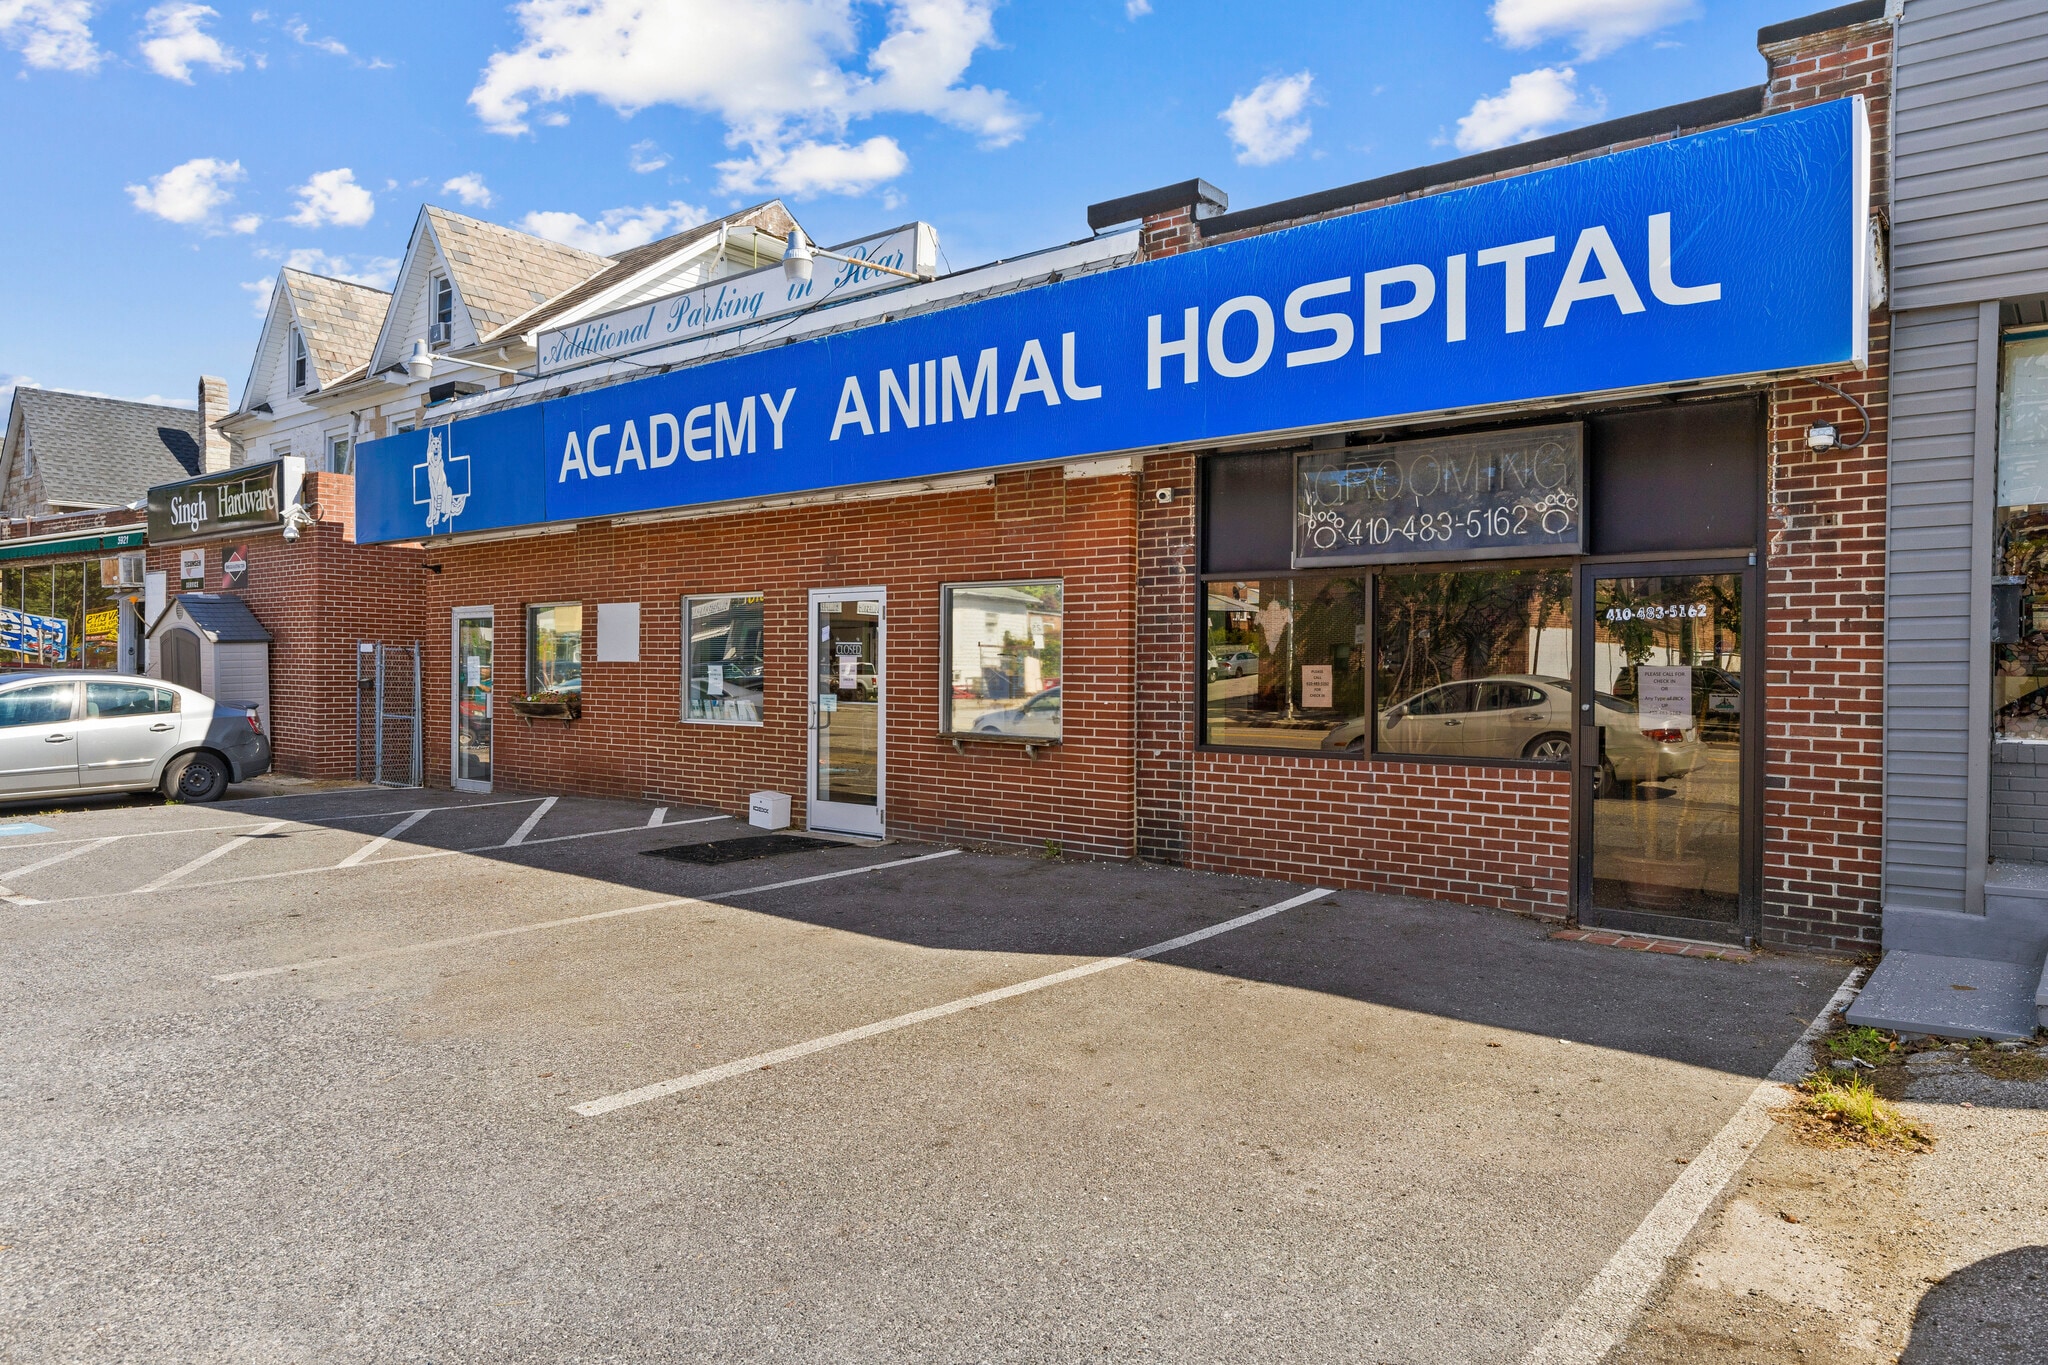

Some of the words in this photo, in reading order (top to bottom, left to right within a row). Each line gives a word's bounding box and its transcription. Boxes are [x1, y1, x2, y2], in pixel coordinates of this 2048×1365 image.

[543, 306, 655, 366] Additional
[667, 285, 765, 333] Parking
[788, 279, 814, 301] in
[834, 245, 905, 289] Rear
[559, 388, 796, 483] ACADEMY
[830, 332, 1102, 440] ANIMAL
[1147, 211, 1722, 390] HOSPITAL
[1314, 442, 1568, 507] GROOMING
[171, 491, 208, 532] Singh
[217, 480, 275, 518] Hardware
[1348, 506, 1528, 545] 410-483-5162
[1606, 604, 1707, 621] 410-483-5162
[836, 643, 862, 655] CLOSED
